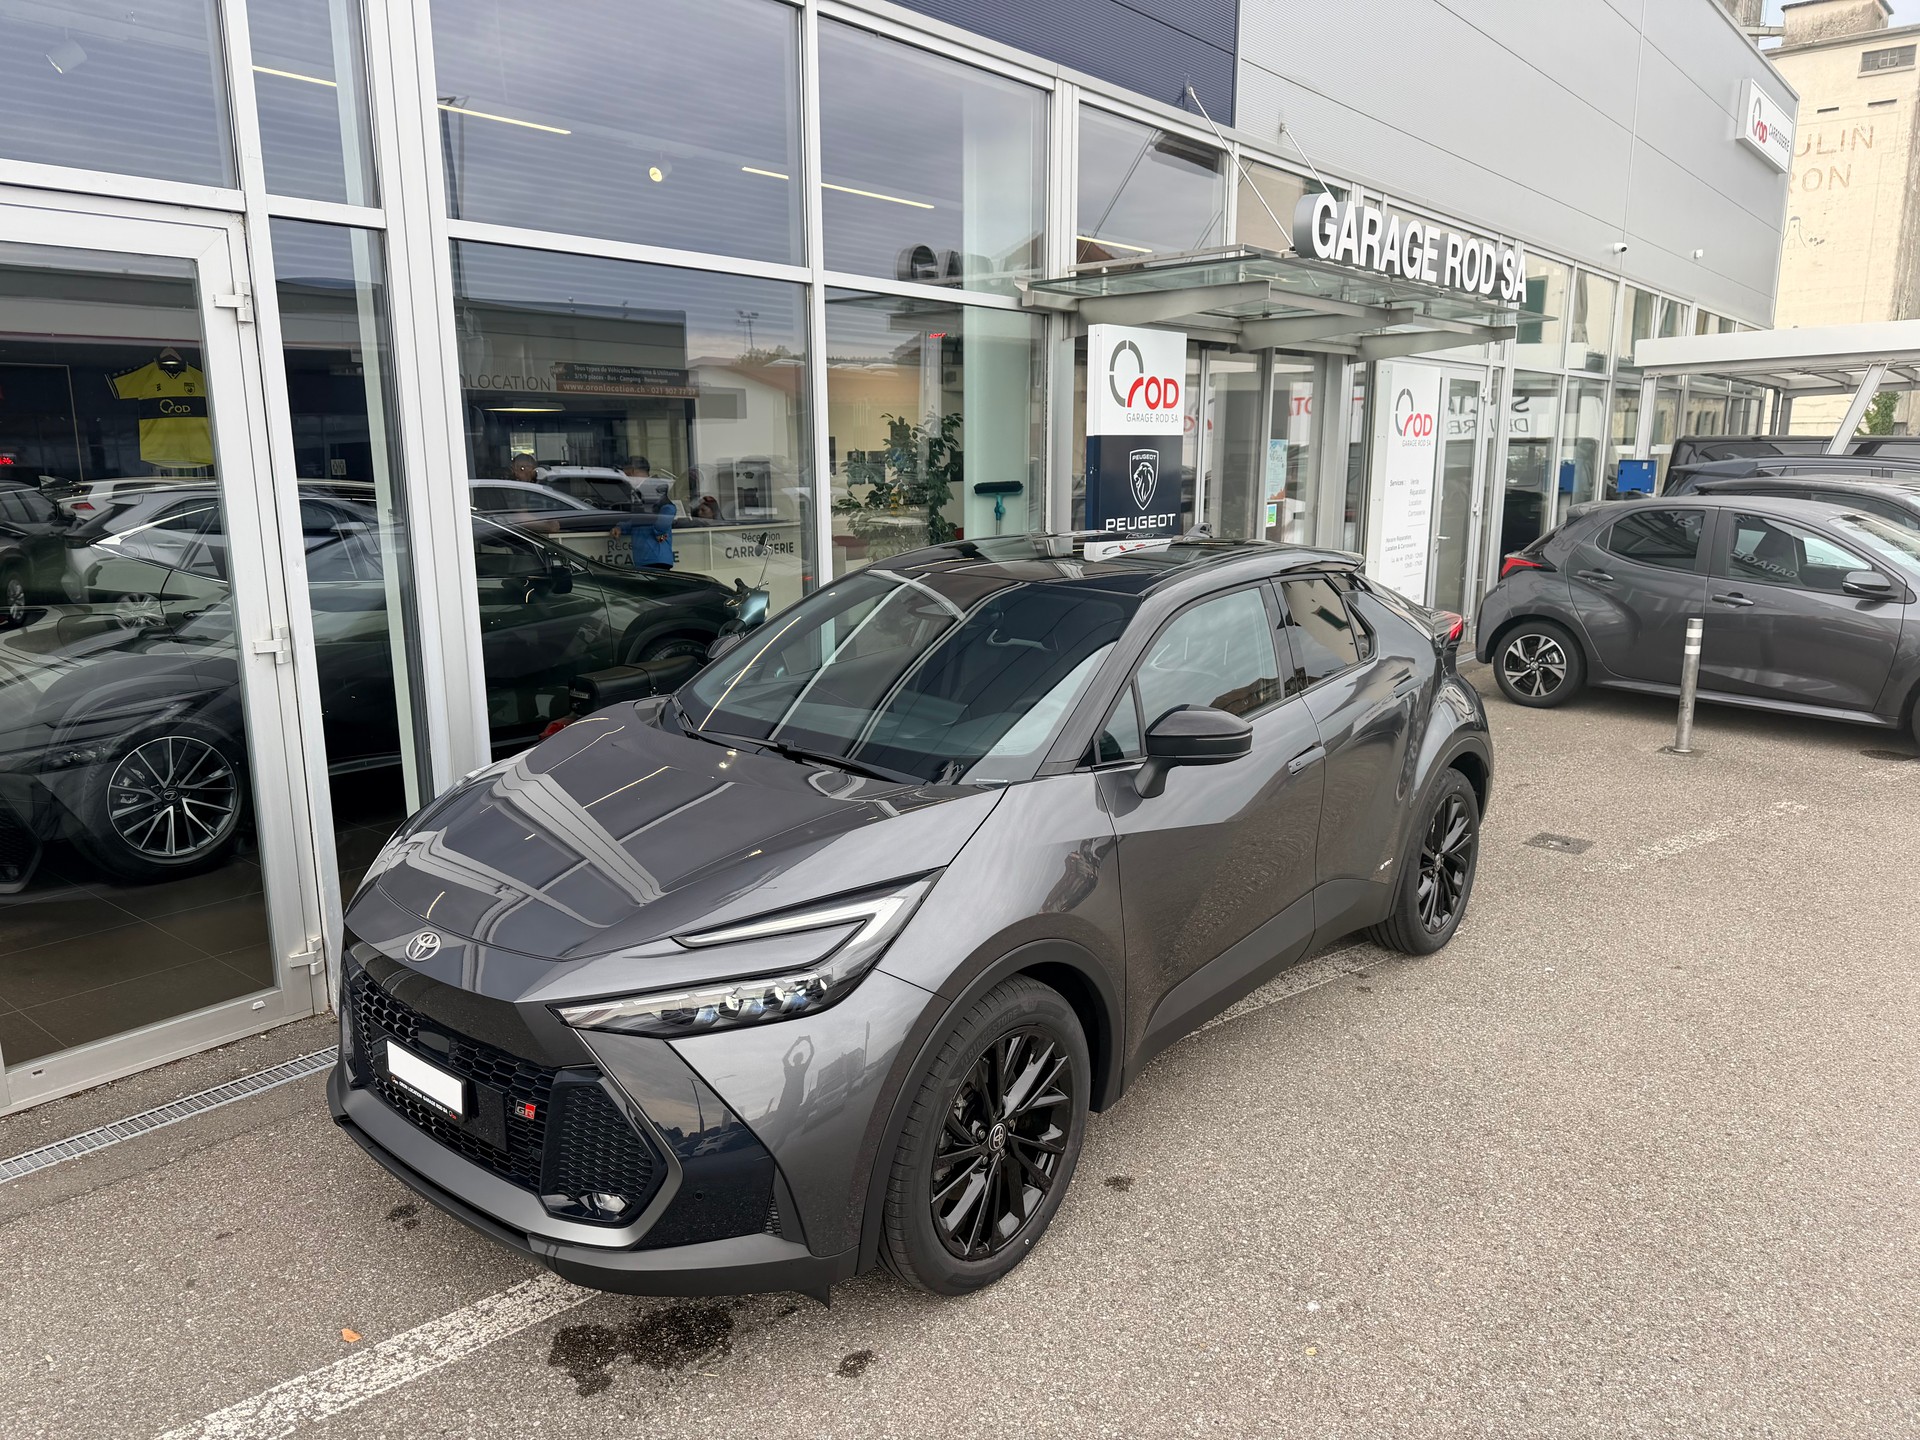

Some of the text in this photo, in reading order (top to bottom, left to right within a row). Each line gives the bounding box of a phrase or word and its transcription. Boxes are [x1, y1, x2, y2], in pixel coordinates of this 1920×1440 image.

[1794, 126, 1873, 157] ULIN
[1312, 193, 1527, 303] GARAGE ROD SA
[469, 373, 551, 391] LOCATION
[563, 383, 645, 394] www.oronlocation.ch
[1126, 413, 1179, 423] GARAGE ROD SA
[1105, 513, 1176, 531] PEUGEOT
[741, 531, 780, 543] Réceion
[725, 541, 794, 559] CARRSSERIE
[407, 1086, 423, 1098] LOCATION
[422, 1095, 436, 1107] GARAGE
[516, 1105, 535, 1119] GR
